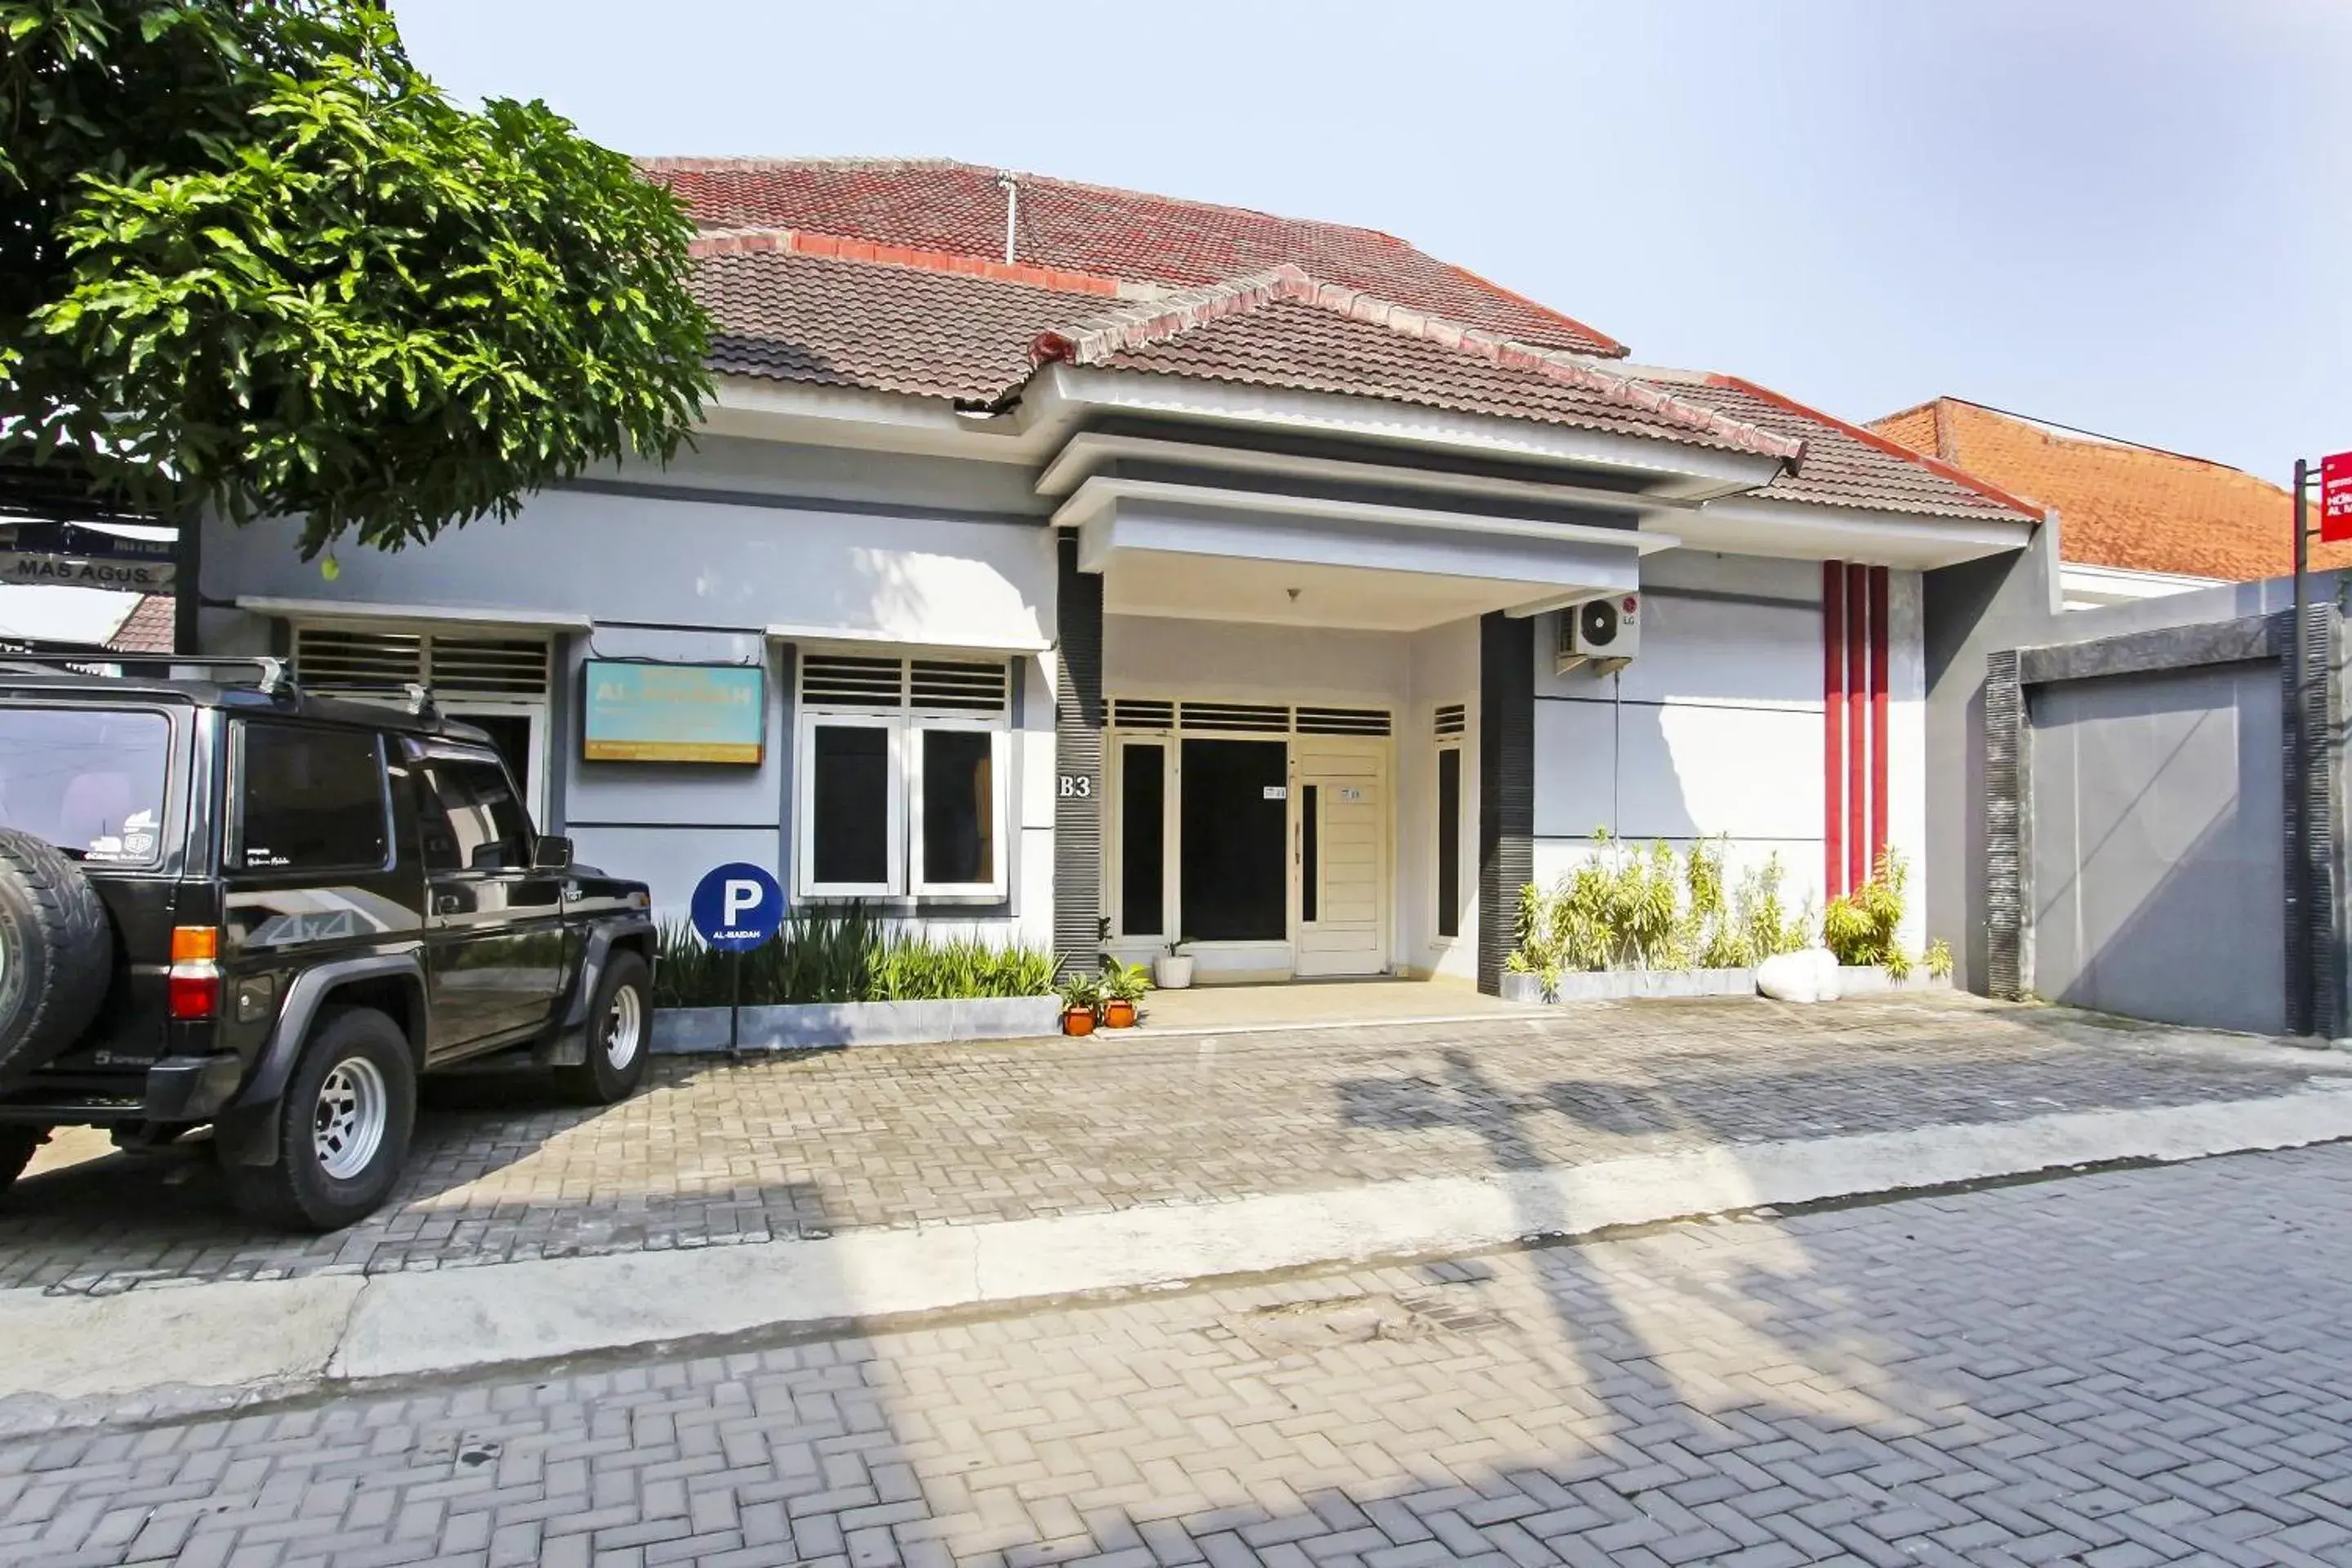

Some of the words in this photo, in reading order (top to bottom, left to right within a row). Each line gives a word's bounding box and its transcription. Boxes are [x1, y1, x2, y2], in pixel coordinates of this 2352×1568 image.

[18, 559, 74, 578] MAS
[79, 564, 150, 583] AGUS
[1623, 616, 1635, 626] LG
[1059, 775, 1091, 798] B3
[724, 879, 764, 927] P
